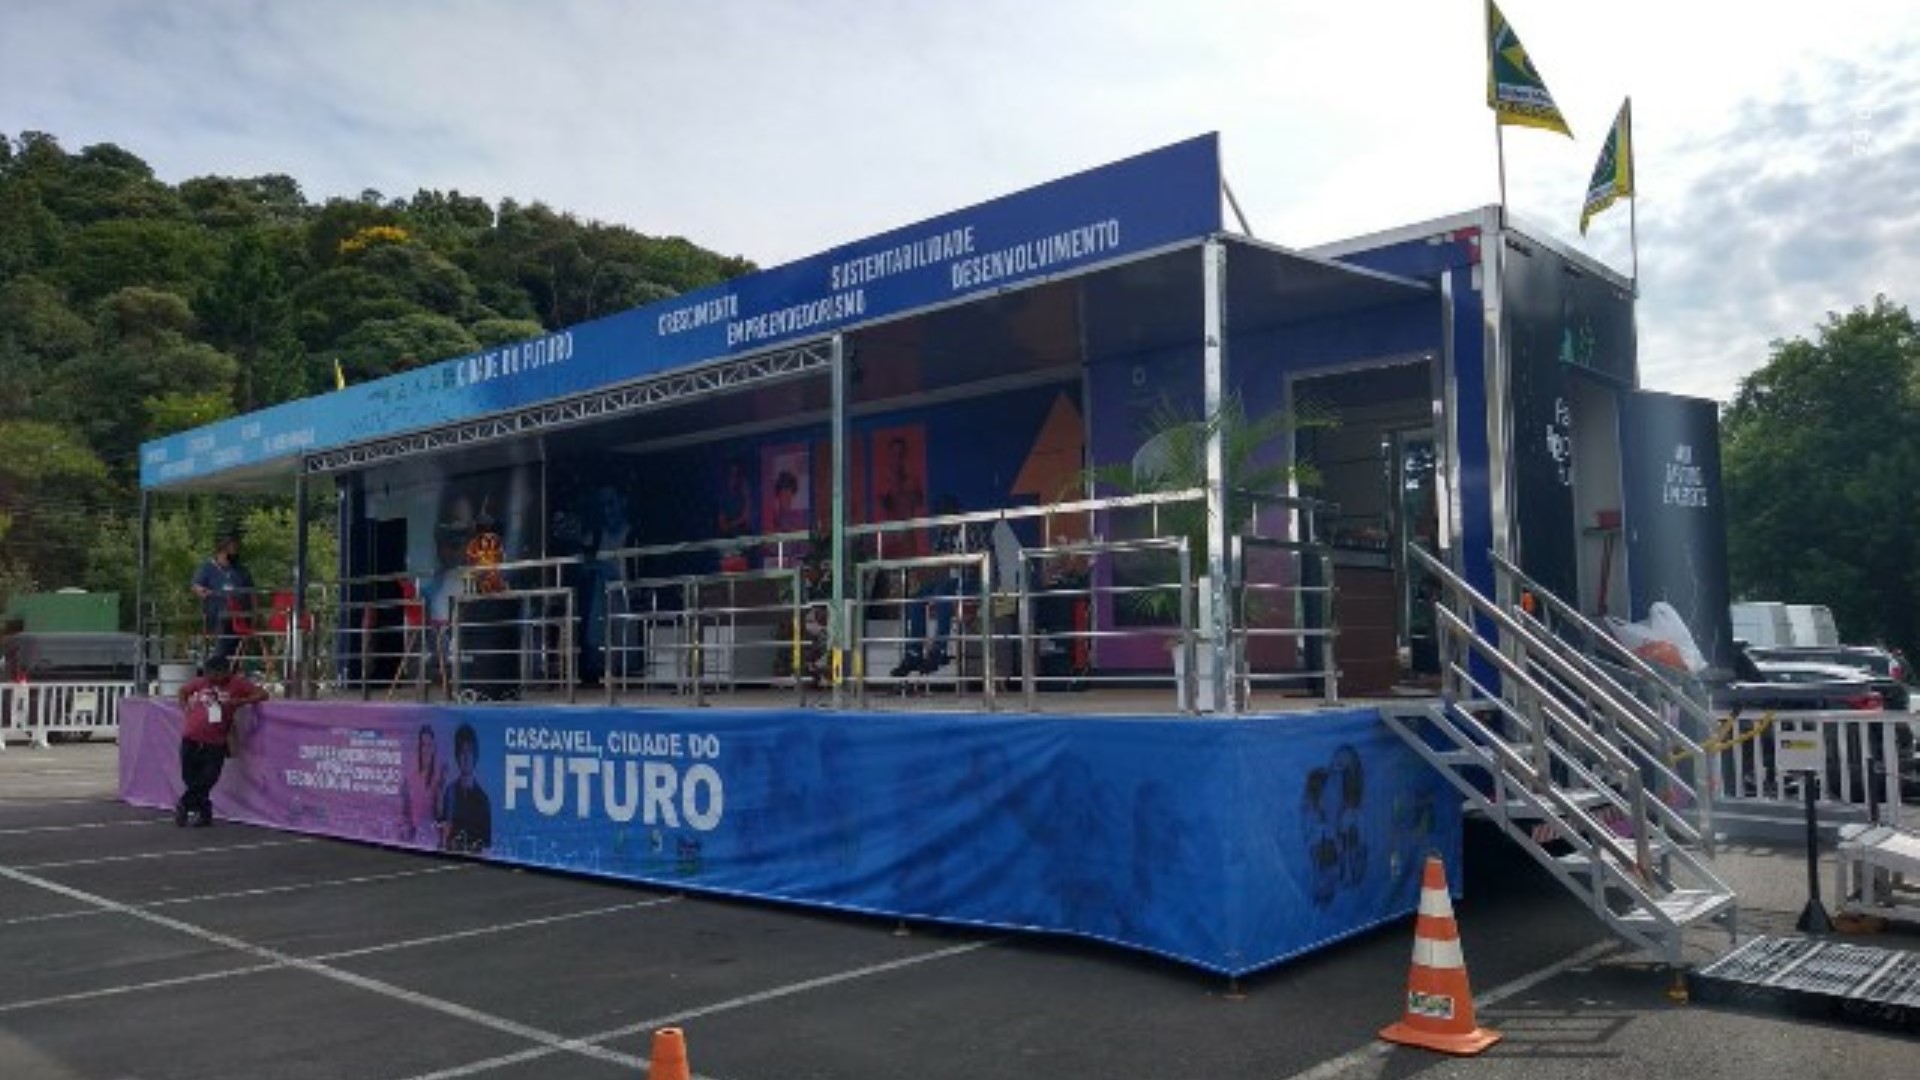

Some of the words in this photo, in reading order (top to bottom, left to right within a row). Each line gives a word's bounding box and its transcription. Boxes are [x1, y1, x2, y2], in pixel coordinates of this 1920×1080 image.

[950, 218, 1121, 291] DESENVOLVIMENTO
[725, 288, 867, 348] EMPREENDEDORISMO
[505, 727, 603, 759] CASCAVEL,
[607, 731, 684, 756] CIDADE
[687, 733, 720, 759] DO
[504, 753, 724, 832] FUTURO
